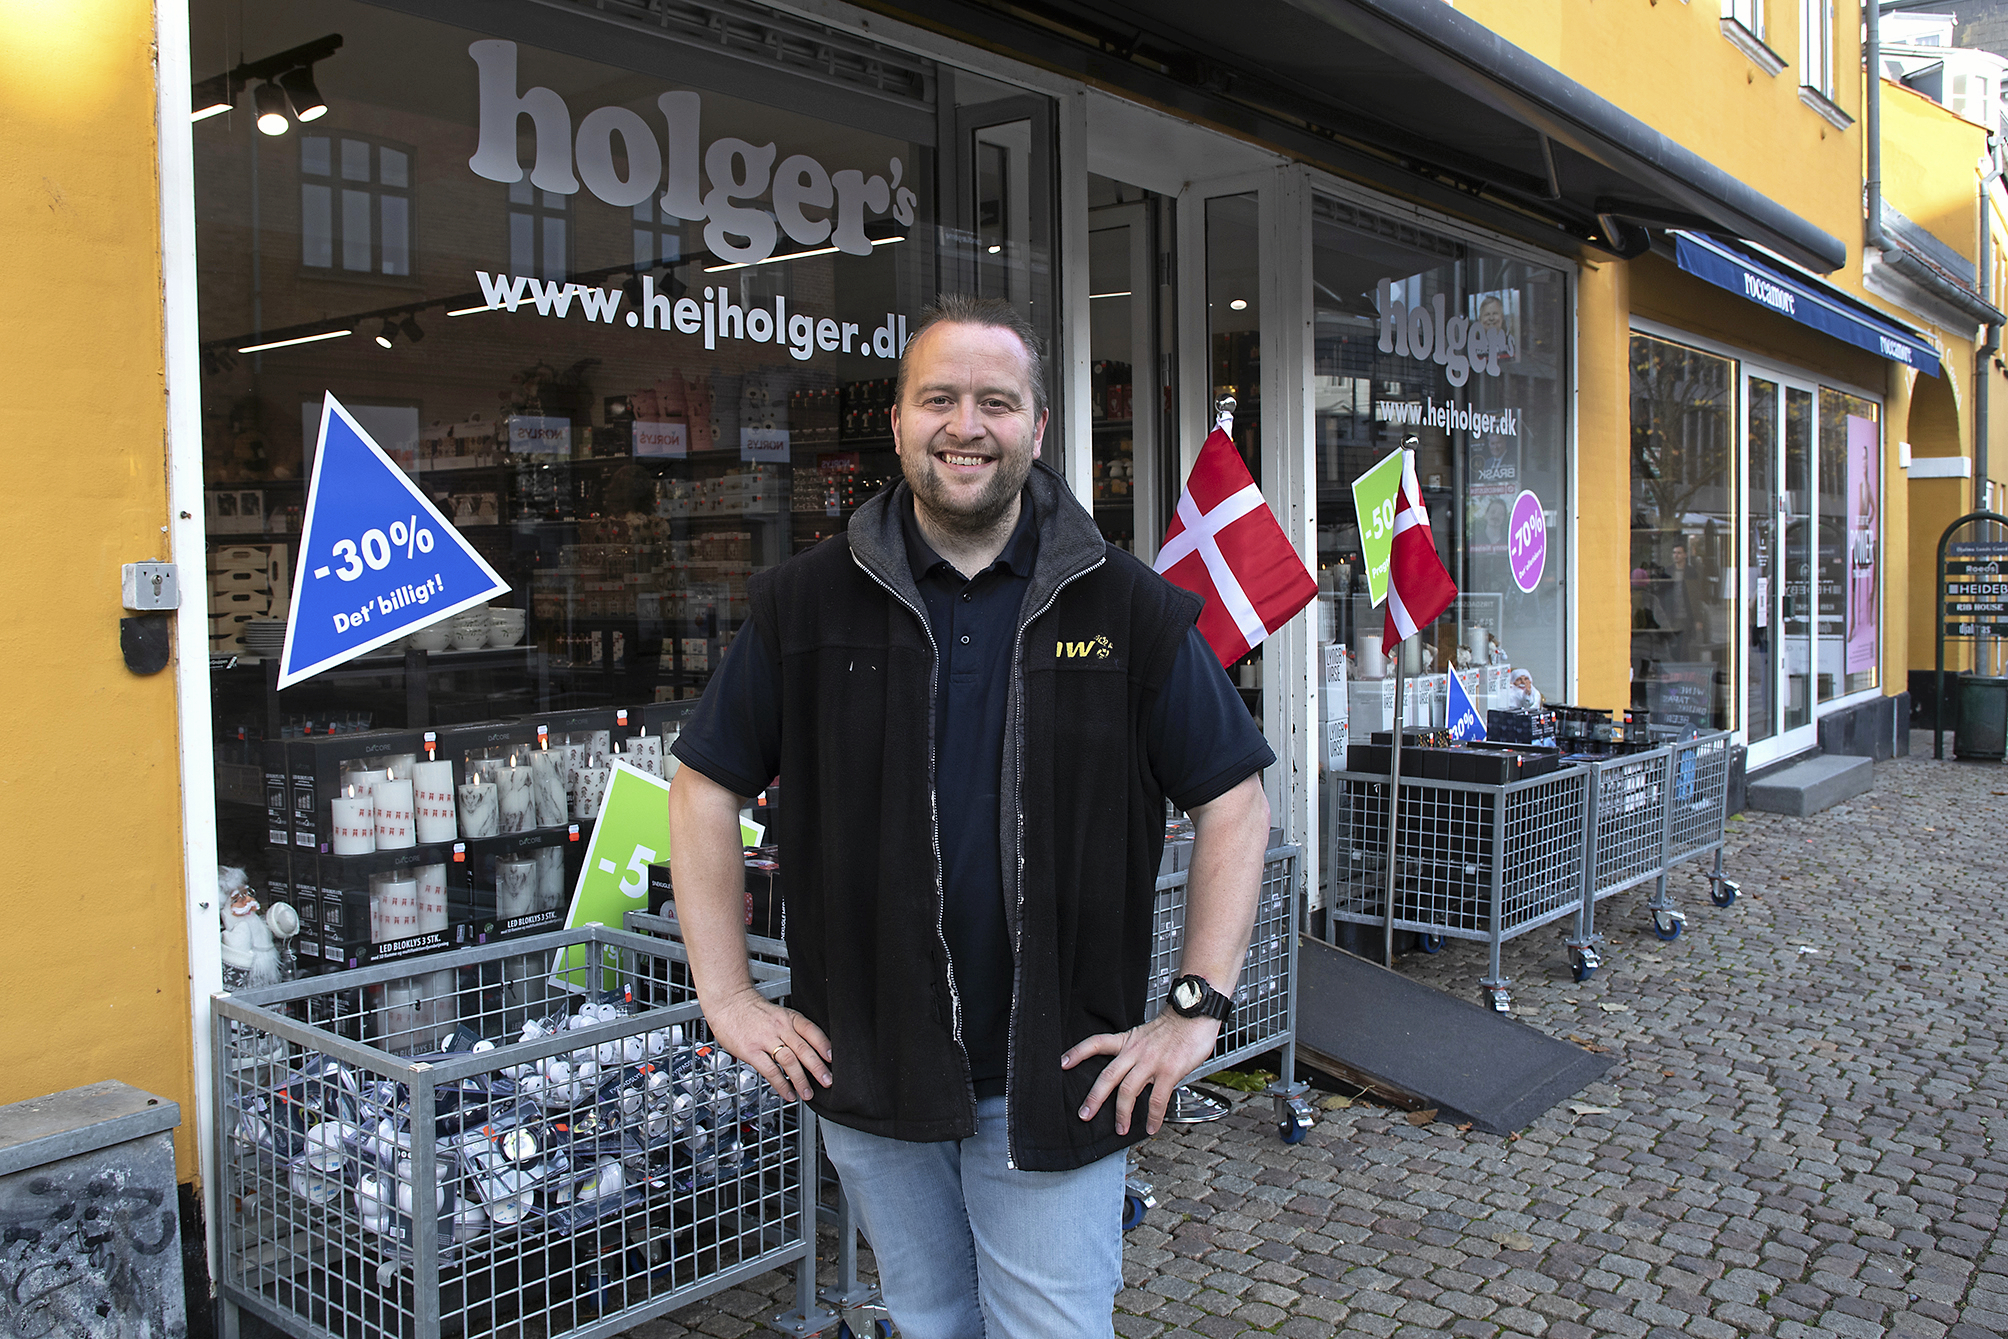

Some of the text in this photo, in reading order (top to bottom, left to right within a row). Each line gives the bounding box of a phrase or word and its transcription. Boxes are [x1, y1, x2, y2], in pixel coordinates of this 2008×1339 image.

[468, 39, 917, 265] holger's
[1743, 272, 1796, 315] roccamore
[475, 270, 915, 361] www.hejholger.dk
[1377, 277, 1516, 388] holger's
[1380, 396, 1517, 439] www.hejholger.dk
[314, 515, 435, 582] -30%
[1511, 509, 1543, 557] -70%
[333, 573, 444, 634] Det' billigt!
[1974, 603, 2004, 611] HOUSE
[1327, 665, 1341, 682] VASE
[1330, 739, 1343, 757] VASE
[507, 911, 557, 928] LED BLOKLYS 3 STK.
[379, 934, 441, 953] LED BLOKLYS 3 STK.
